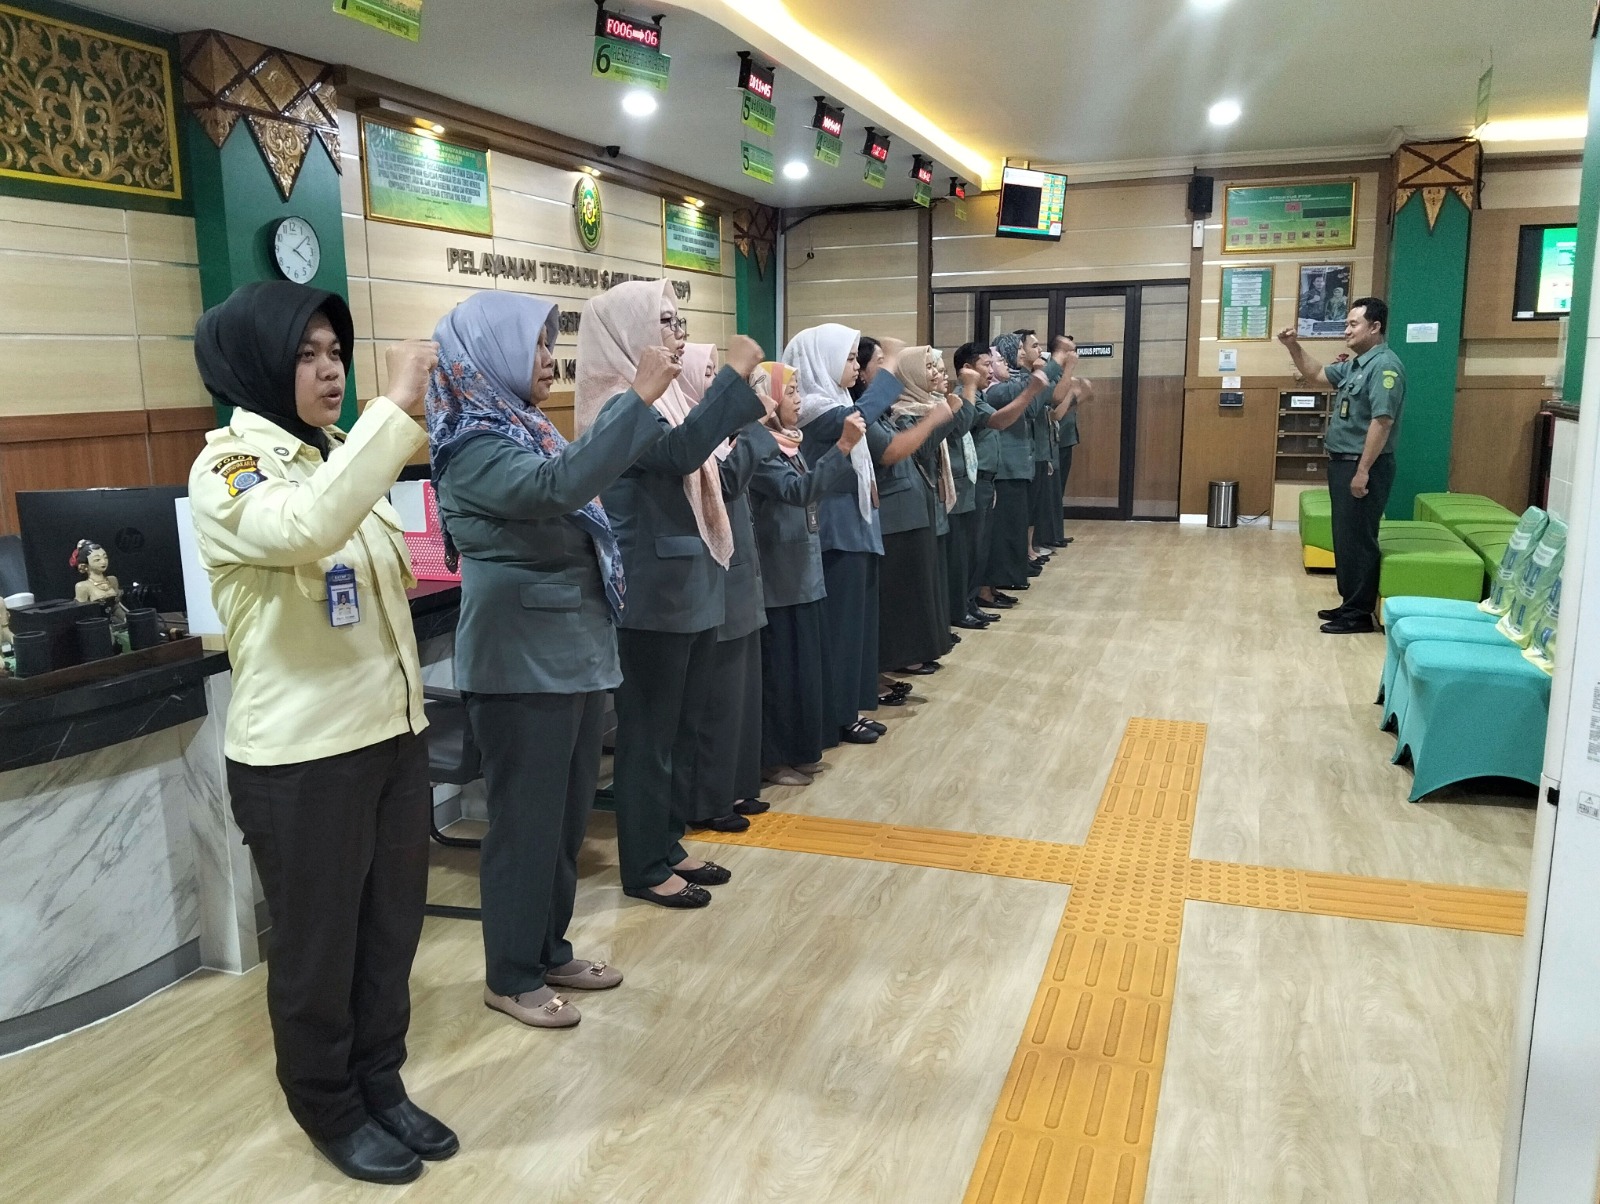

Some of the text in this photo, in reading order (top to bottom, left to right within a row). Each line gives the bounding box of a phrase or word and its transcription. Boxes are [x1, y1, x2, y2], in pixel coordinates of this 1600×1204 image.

[606, 18, 658, 46] F006 06
[596, 44, 611, 74] 6
[743, 94, 752, 121] 5
[742, 146, 751, 171] 5
[447, 248, 537, 282] PELAYANAN
[540, 262, 599, 289] TERPADU
[1093, 346, 1111, 356] PETUGAS
[216, 455, 254, 469] POLDA
